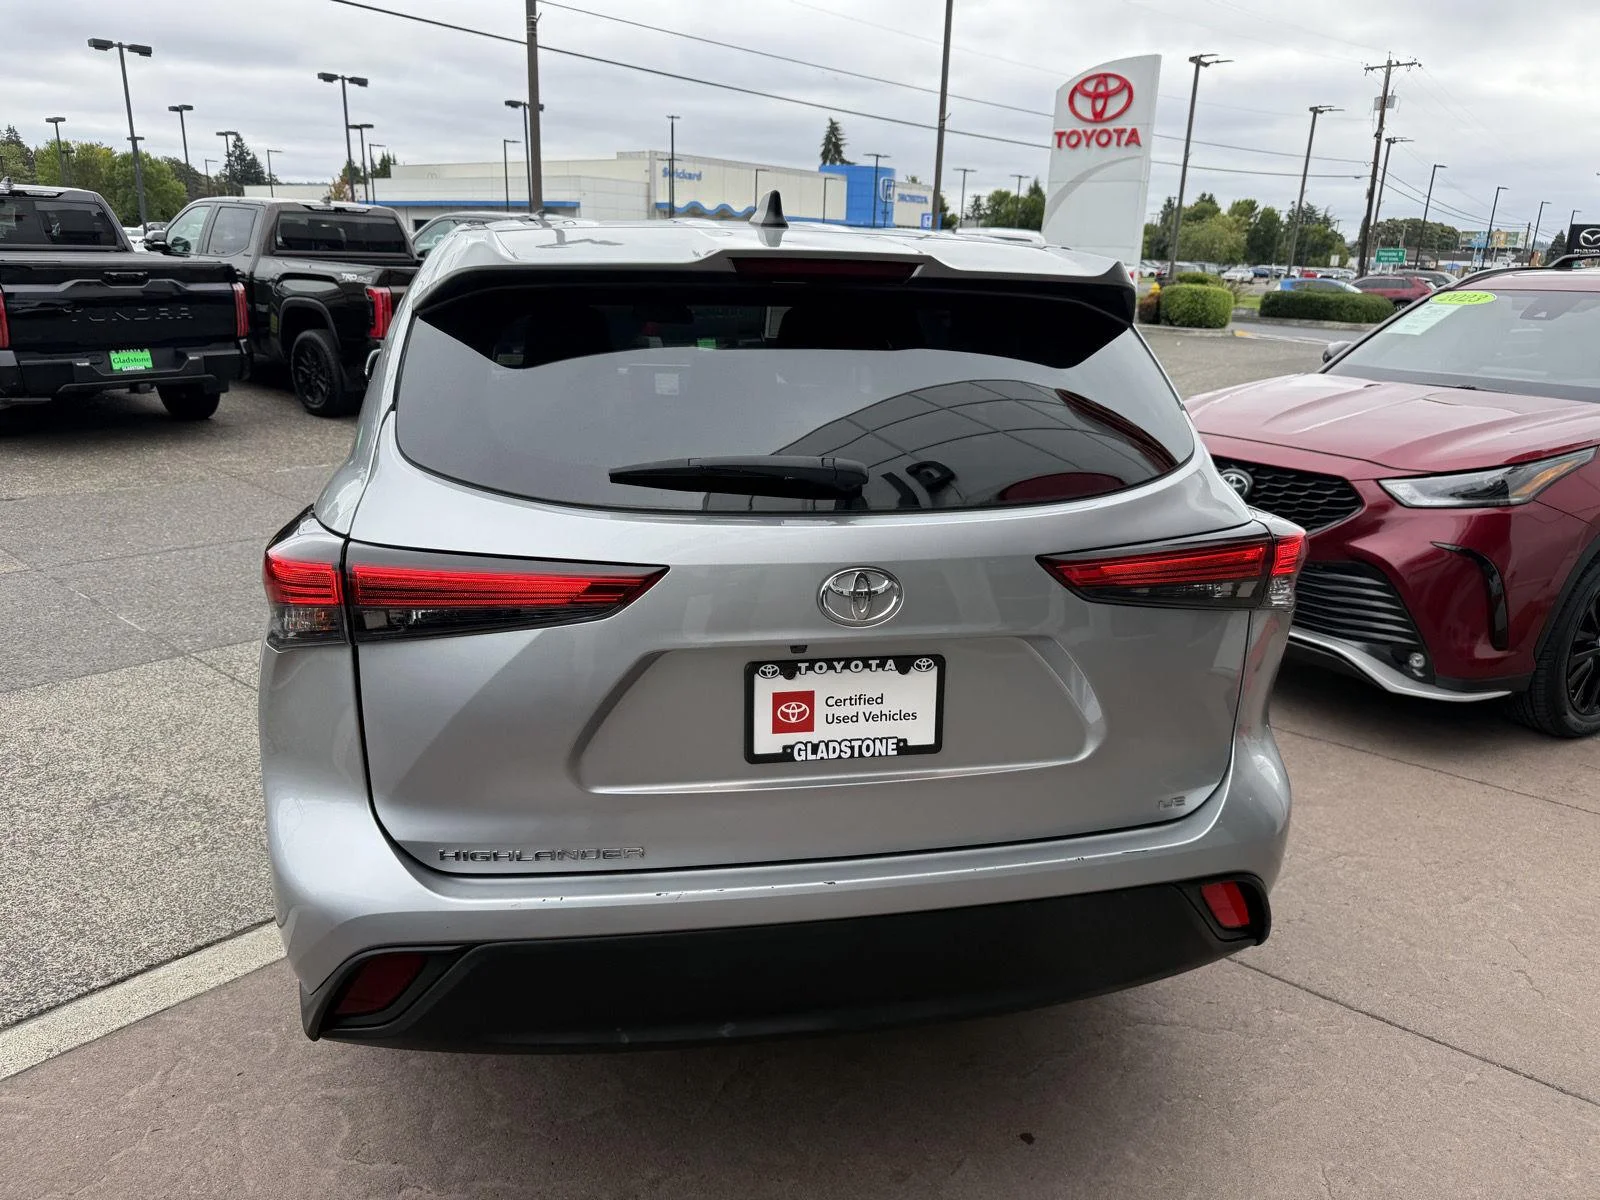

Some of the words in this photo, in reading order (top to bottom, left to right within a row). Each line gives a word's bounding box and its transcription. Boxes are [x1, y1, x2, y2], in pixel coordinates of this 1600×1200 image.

[1054, 127, 1142, 149] TOYOTA
[63, 306, 193, 322] TUNDRA
[112, 356, 150, 364] Gladstone
[798, 660, 897, 675] TOYOTA
[825, 693, 884, 708] Certified
[825, 712, 859, 725] Used
[863, 710, 918, 722] Vehicles
[793, 738, 898, 761] GLADSTONE
[1158, 795, 1186, 809] LE
[438, 847, 645, 862] HIGHLANDER
